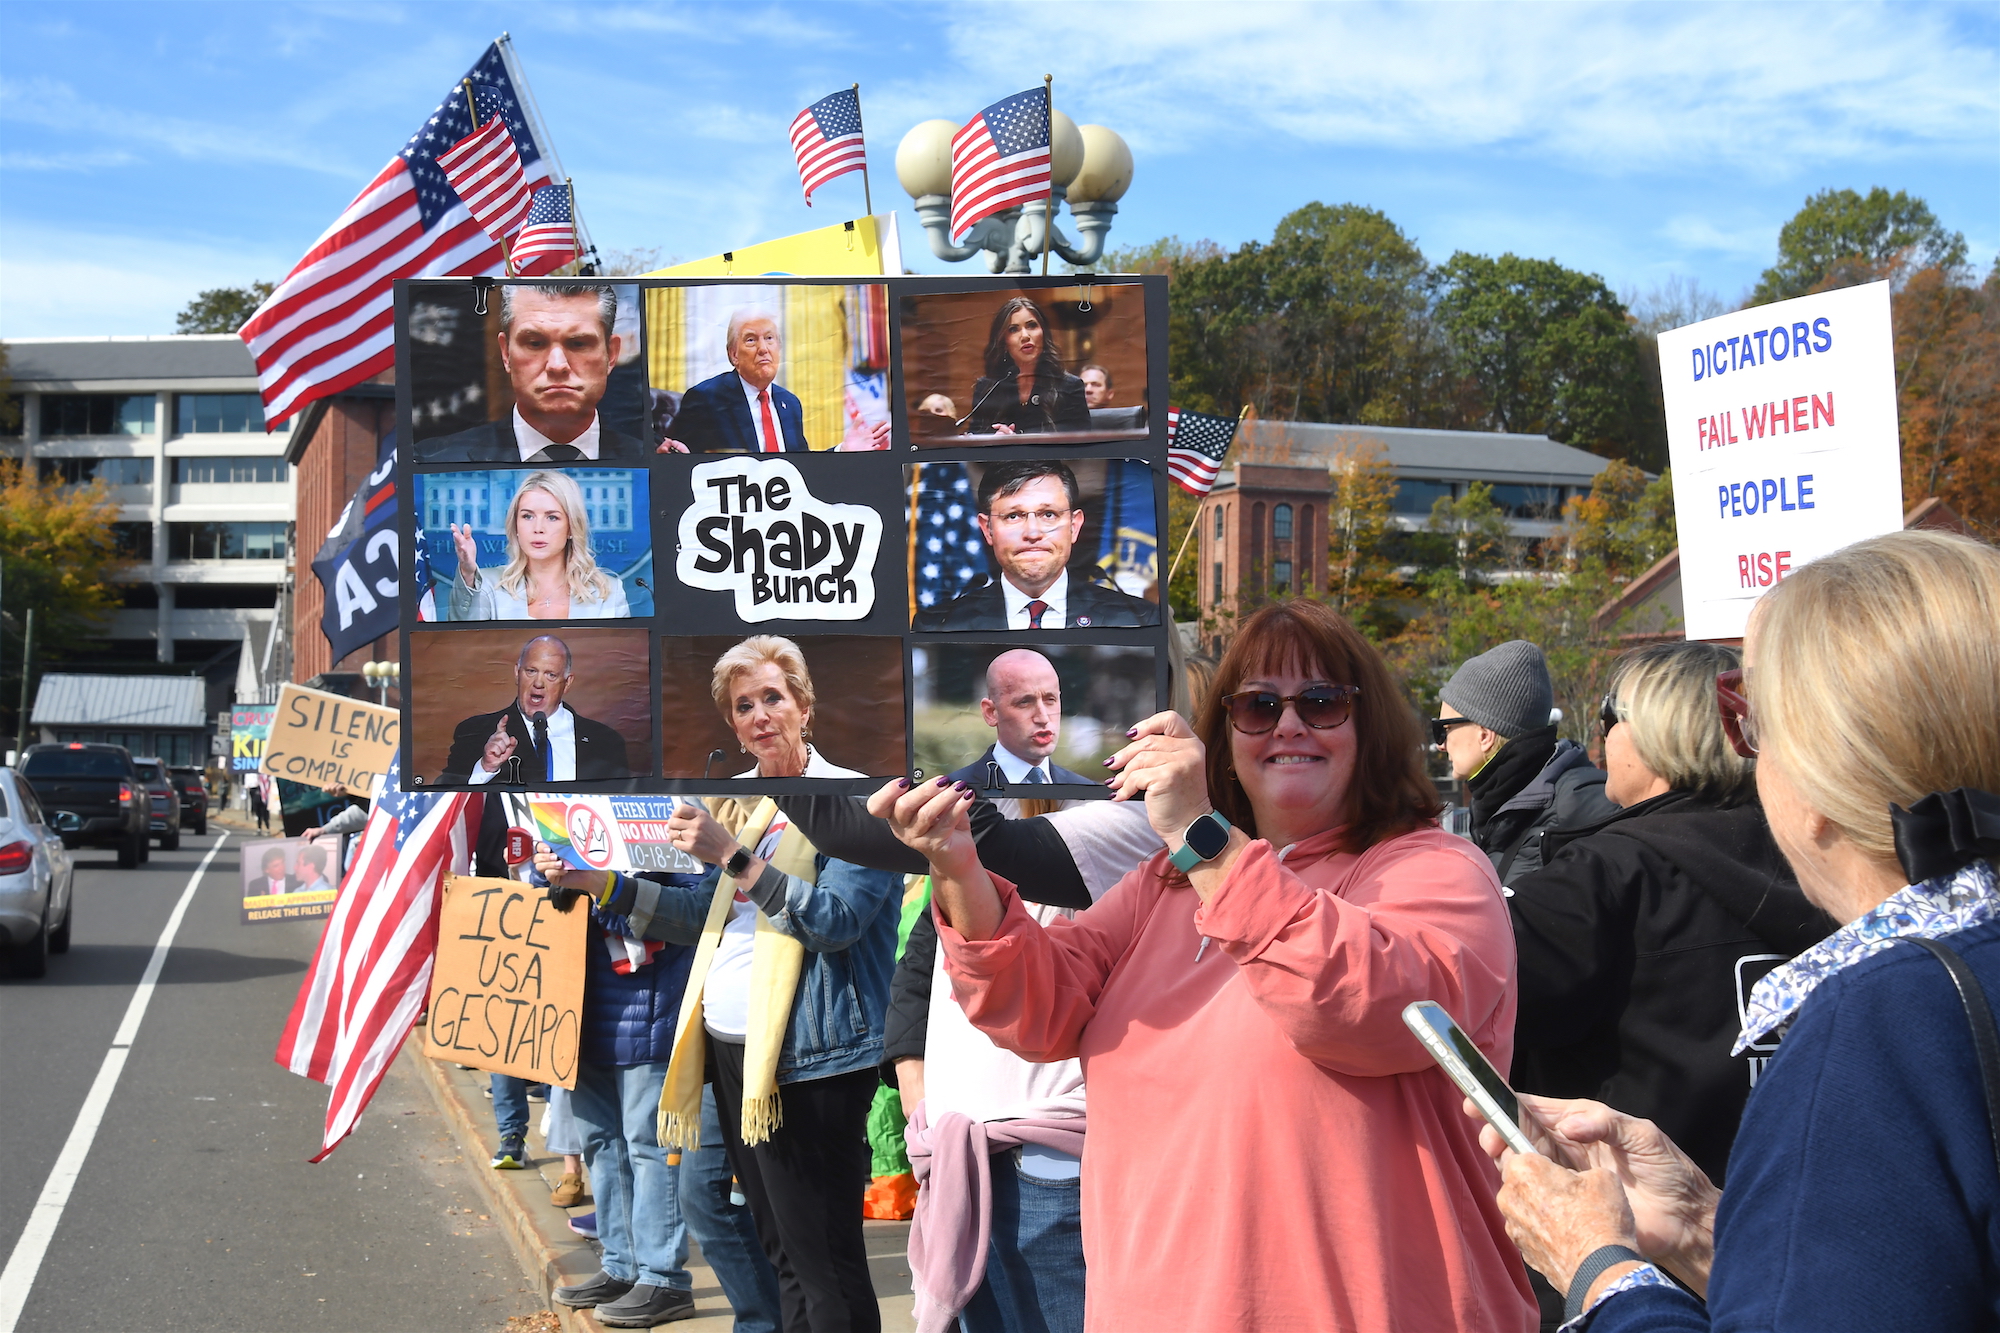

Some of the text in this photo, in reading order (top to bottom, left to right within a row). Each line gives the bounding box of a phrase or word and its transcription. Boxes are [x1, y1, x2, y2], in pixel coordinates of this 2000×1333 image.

[1692, 317, 1833, 382] DICTATORS
[1698, 391, 1836, 452] FAIL WHEN
[707, 474, 792, 515] The
[1718, 474, 1815, 519] PEOPLE
[752, 572, 857, 606] Bunch
[1738, 551, 1791, 589] RISE
[232, 711, 275, 726] CRU
[288, 695, 399, 746] SILENC
[233, 757, 261, 770] SIN
[331, 739, 353, 758] IS
[265, 752, 375, 791] COMPLICI
[611, 802, 648, 818] THEN
[619, 823, 641, 840] NO
[628, 843, 693, 869] 10-18-25
[248, 909, 283, 920] RELEASE
[283, 907, 300, 917] THE
[300, 905, 323, 915] FILES
[458, 887, 551, 950] ICE
[478, 944, 542, 999] USA
[431, 987, 578, 1081] GESTAPO
